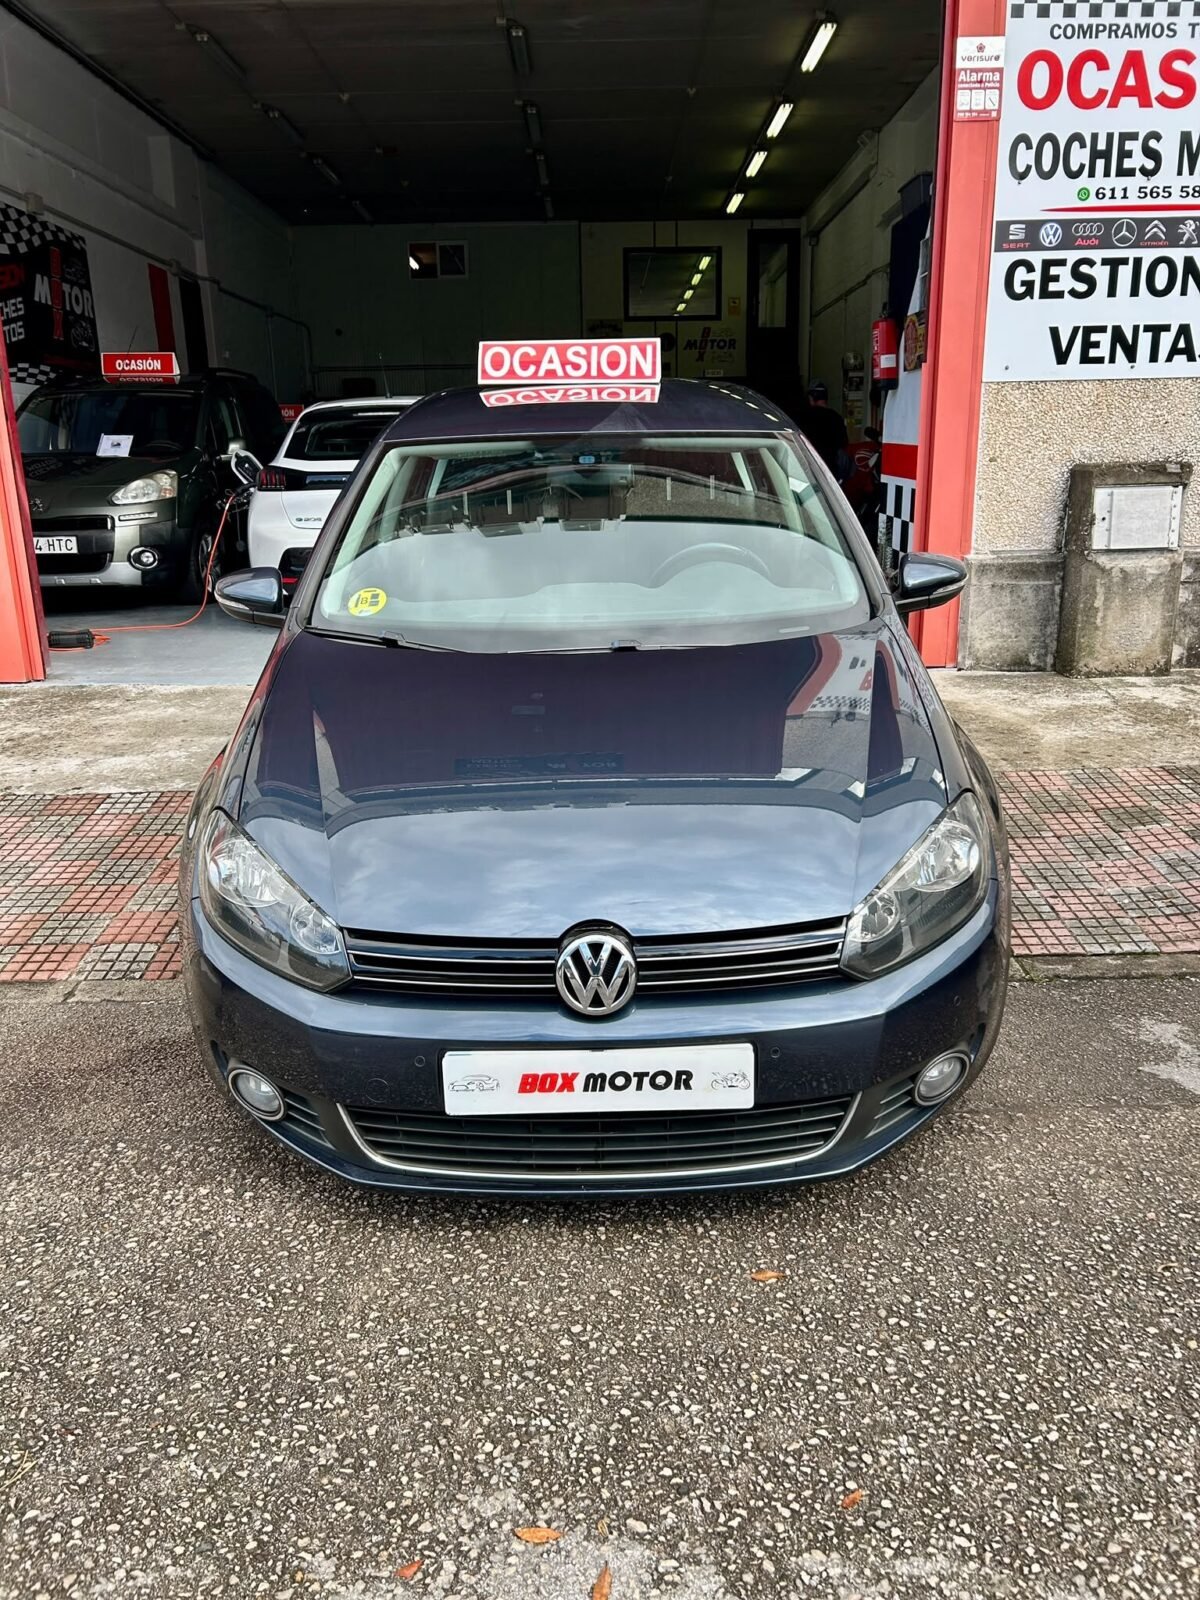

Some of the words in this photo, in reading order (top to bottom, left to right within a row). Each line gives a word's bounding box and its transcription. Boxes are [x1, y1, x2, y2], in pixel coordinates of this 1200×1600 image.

[1049, 22, 1178, 40] COMPRAMOS
[958, 69, 1000, 82] Alarma
[1016, 48, 1197, 111] OCAS
[1008, 130, 1164, 181] COCHES
[1095, 186, 1129, 199] 611
[1137, 185, 1173, 199] 565
[1075, 238, 1099, 246] Audi
[1048, 322, 1200, 366] VENTA
[115, 357, 161, 371] OCASIÓN
[484, 344, 652, 378] OCASION
[47, 538, 73, 551] HTC
[517, 1071, 581, 1094] BOX
[582, 1069, 694, 1094] MOTOR
